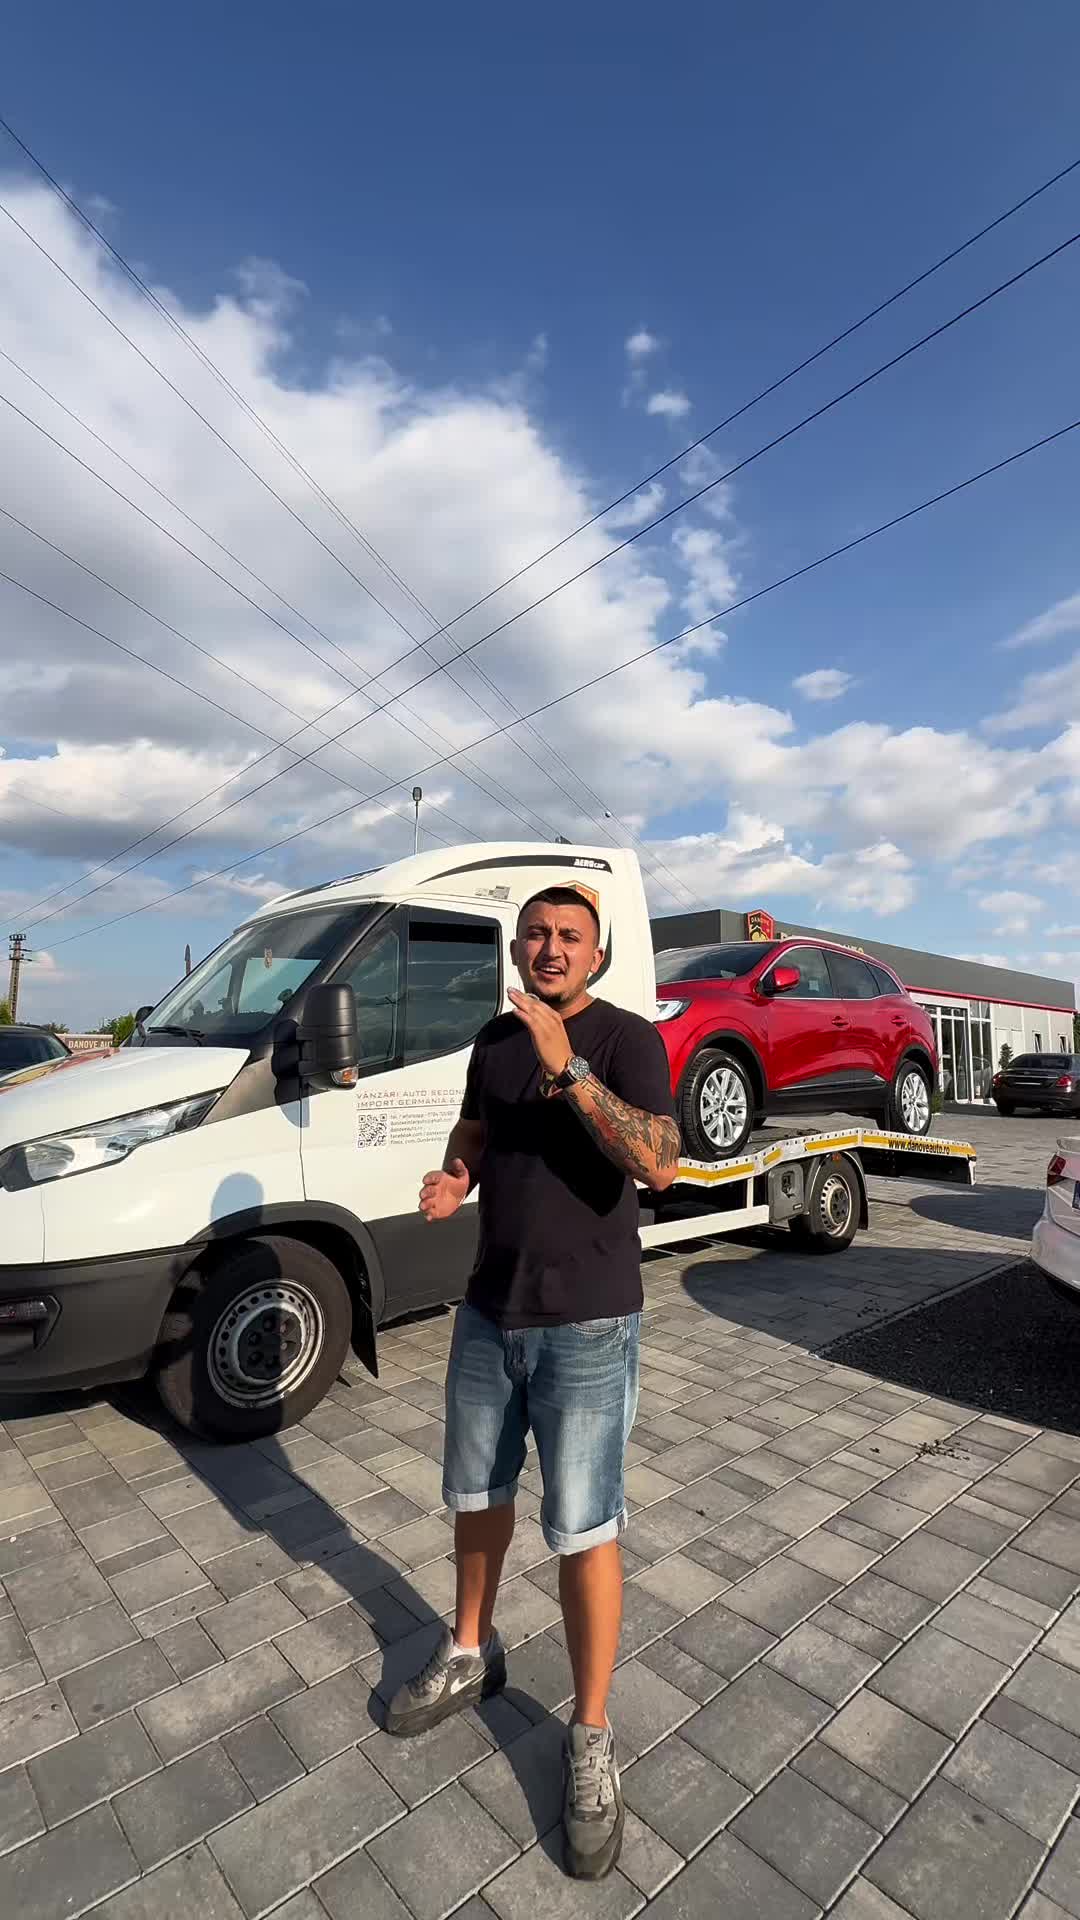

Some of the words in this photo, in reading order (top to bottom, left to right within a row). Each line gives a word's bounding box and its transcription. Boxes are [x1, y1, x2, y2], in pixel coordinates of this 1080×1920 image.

[68, 1040, 98, 1049] DANOVE
[357, 1099, 394, 1108] IMPORT
[398, 1098, 447, 1106] GERMANIA
[888, 1138, 951, 1155] www.danoveauto.ro
